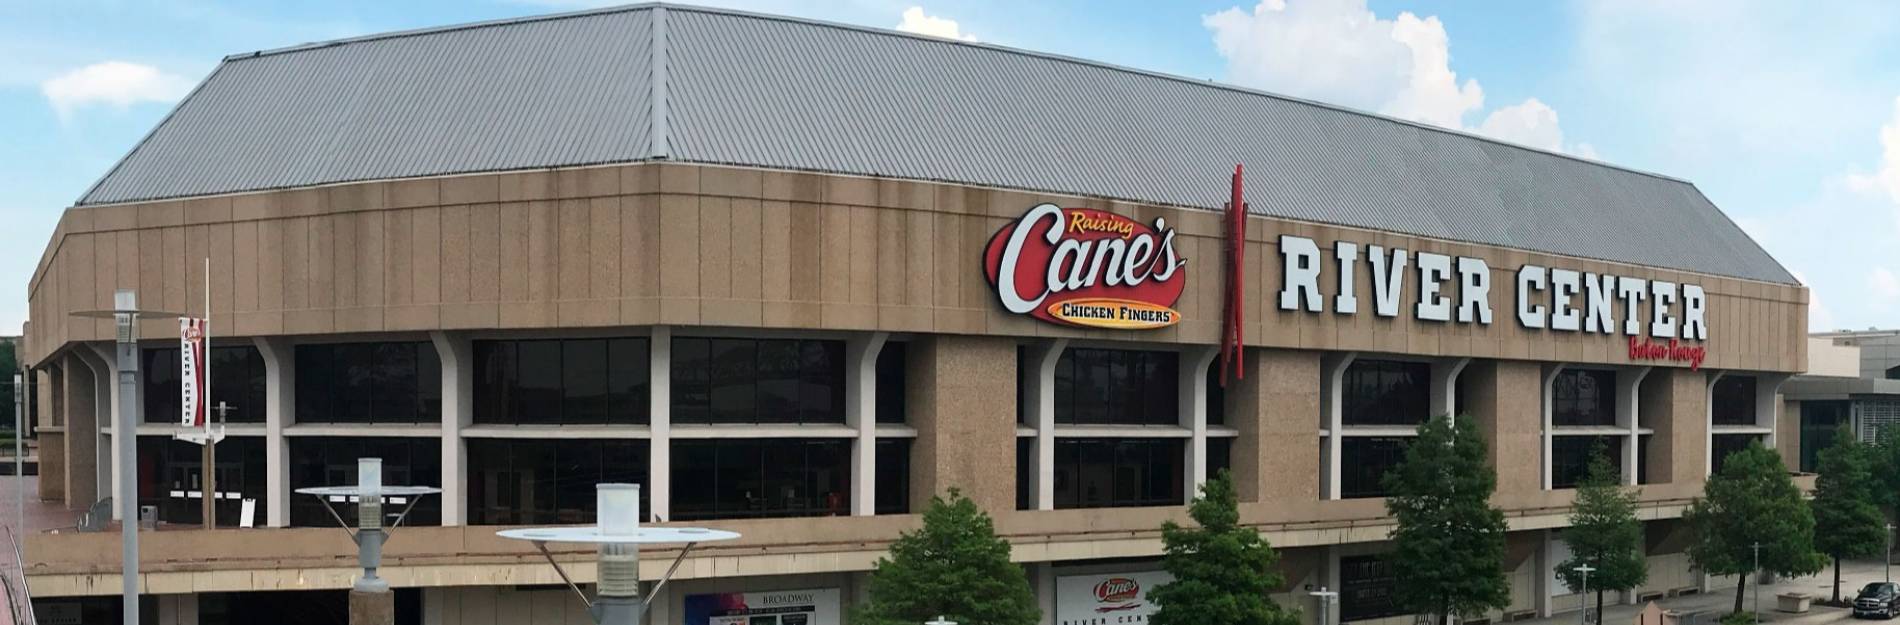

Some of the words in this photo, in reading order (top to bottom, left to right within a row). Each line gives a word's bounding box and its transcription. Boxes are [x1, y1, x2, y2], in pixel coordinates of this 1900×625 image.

[1069, 211, 1134, 240] Raising
[998, 203, 1188, 314] Cane's
[1279, 234, 1493, 324] RIVER
[1516, 264, 1708, 341] CENTER
[1062, 303, 1115, 319] CHICKEN
[1119, 306, 1171, 323] FINGERS
[1628, 335, 1667, 360] Baton
[1668, 339, 1706, 371] Rouge
[763, 594, 815, 605] BROADWAY
[1118, 615, 1142, 624] CEN
